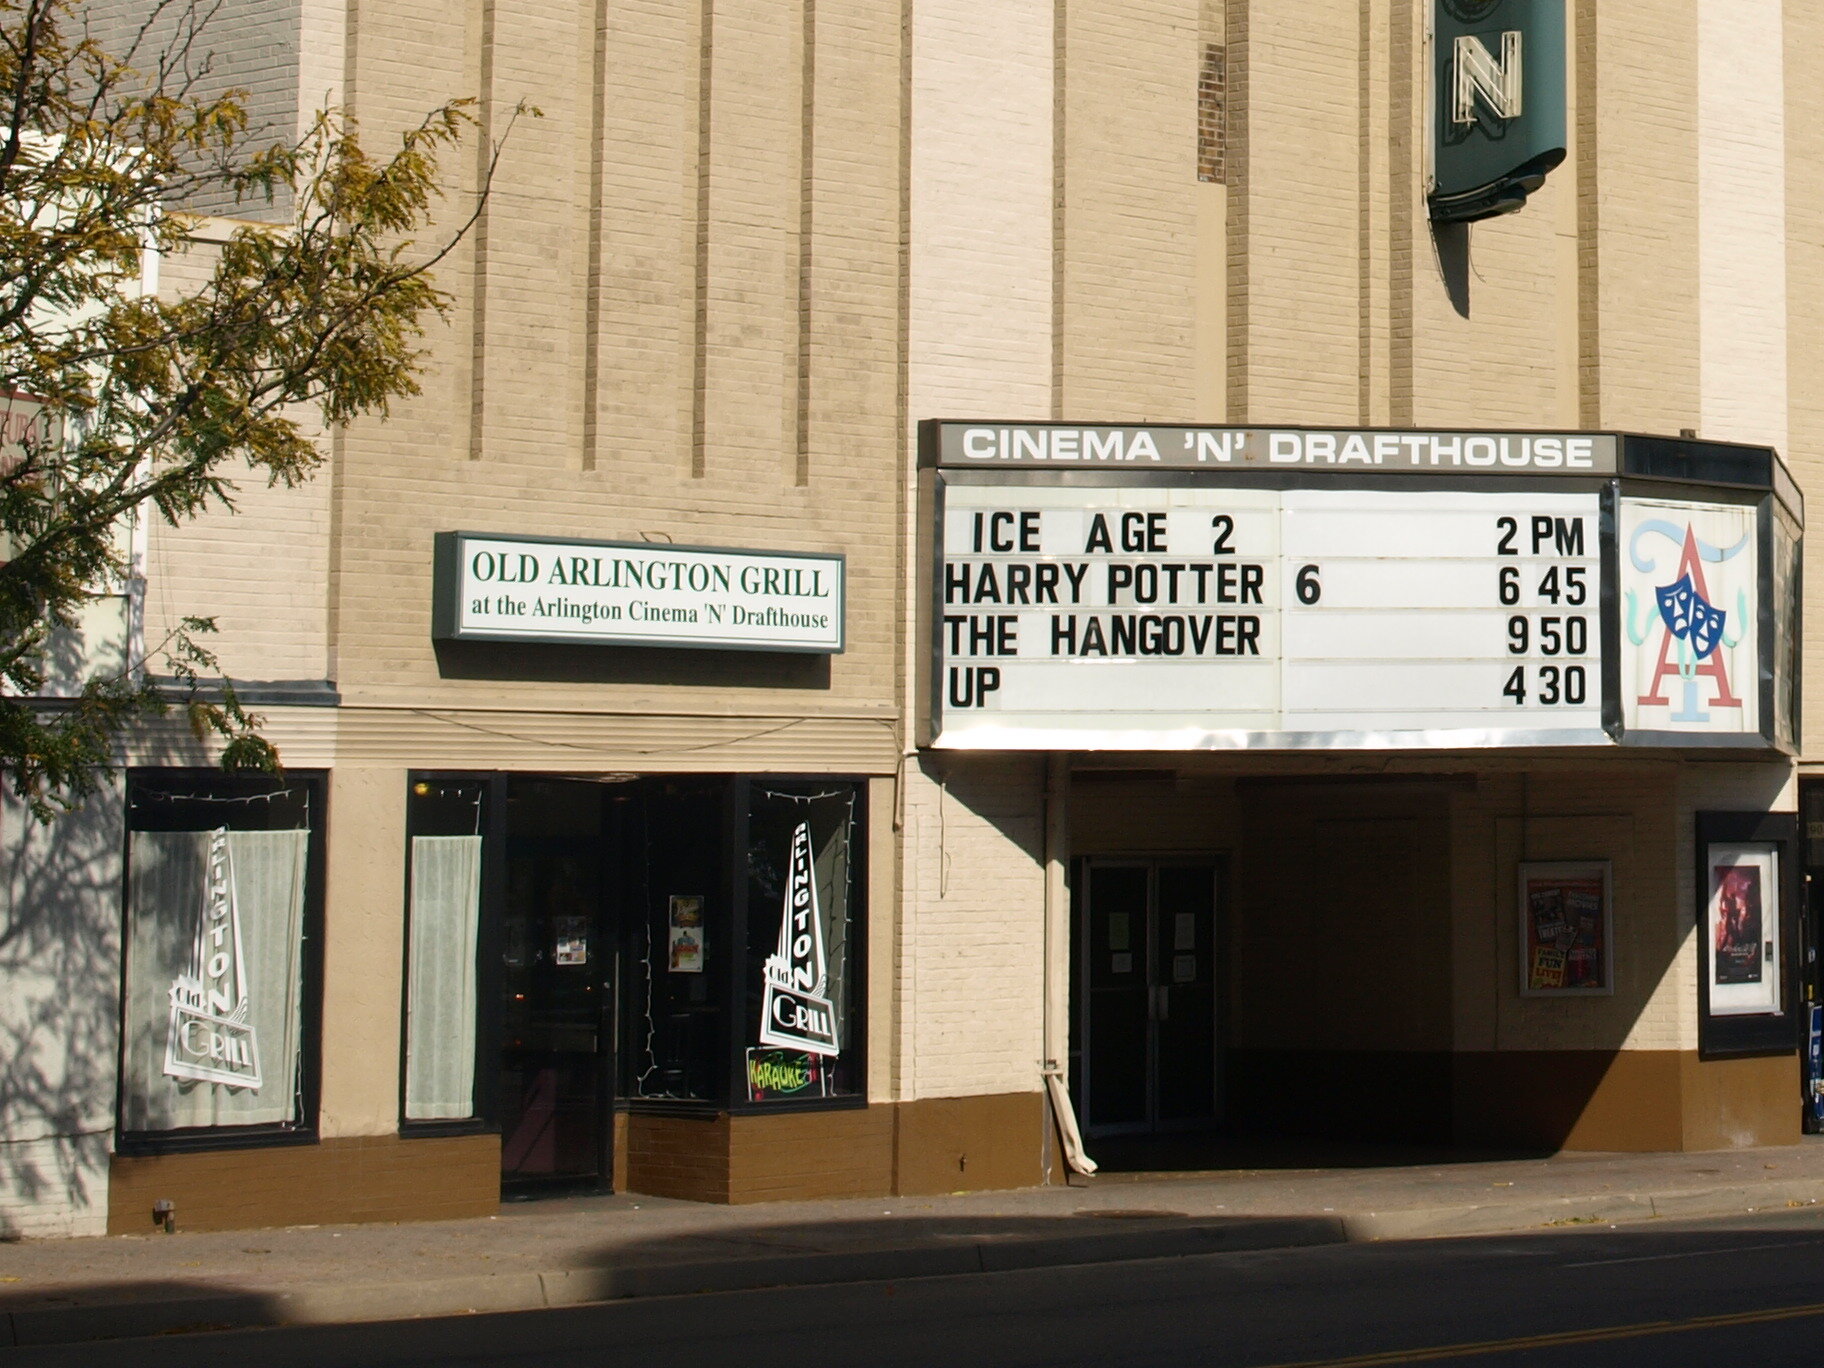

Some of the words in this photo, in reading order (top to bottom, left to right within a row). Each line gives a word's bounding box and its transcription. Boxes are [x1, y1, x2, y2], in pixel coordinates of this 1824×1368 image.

[963, 430, 1160, 461] CINEMA
[1269, 433, 1593, 468] DRAFTHOUSE
[973, 512, 1041, 553] ICE
[1085, 512, 1168, 554] AGE
[1211, 515, 1236, 555] 2
[1496, 517, 1519, 556] 2
[1531, 515, 1584, 557] PM
[472, 551, 540, 584] OLD
[549, 556, 732, 594] ARLINGTON
[740, 566, 829, 599] GRILL
[945, 563, 1089, 605] HARRY
[1108, 563, 1264, 605] POTTER
[1295, 565, 1321, 605] 6
[1499, 567, 1520, 606] 6
[1538, 566, 1587, 606] 45
[472, 597, 490, 615] at
[497, 595, 526, 617] the
[532, 597, 622, 625] Arlington
[628, 601, 698, 624] Cinema
[732, 605, 828, 629] Drafthouse
[944, 615, 1018, 656] THE
[1051, 615, 1261, 656] HANGOVER
[1508, 615, 1529, 655] 9
[1540, 616, 1588, 656] 50
[949, 666, 1000, 708] UP
[1503, 666, 1526, 705] 4
[1539, 666, 1587, 706] 30
[793, 822, 812, 992] ARLINGTON
